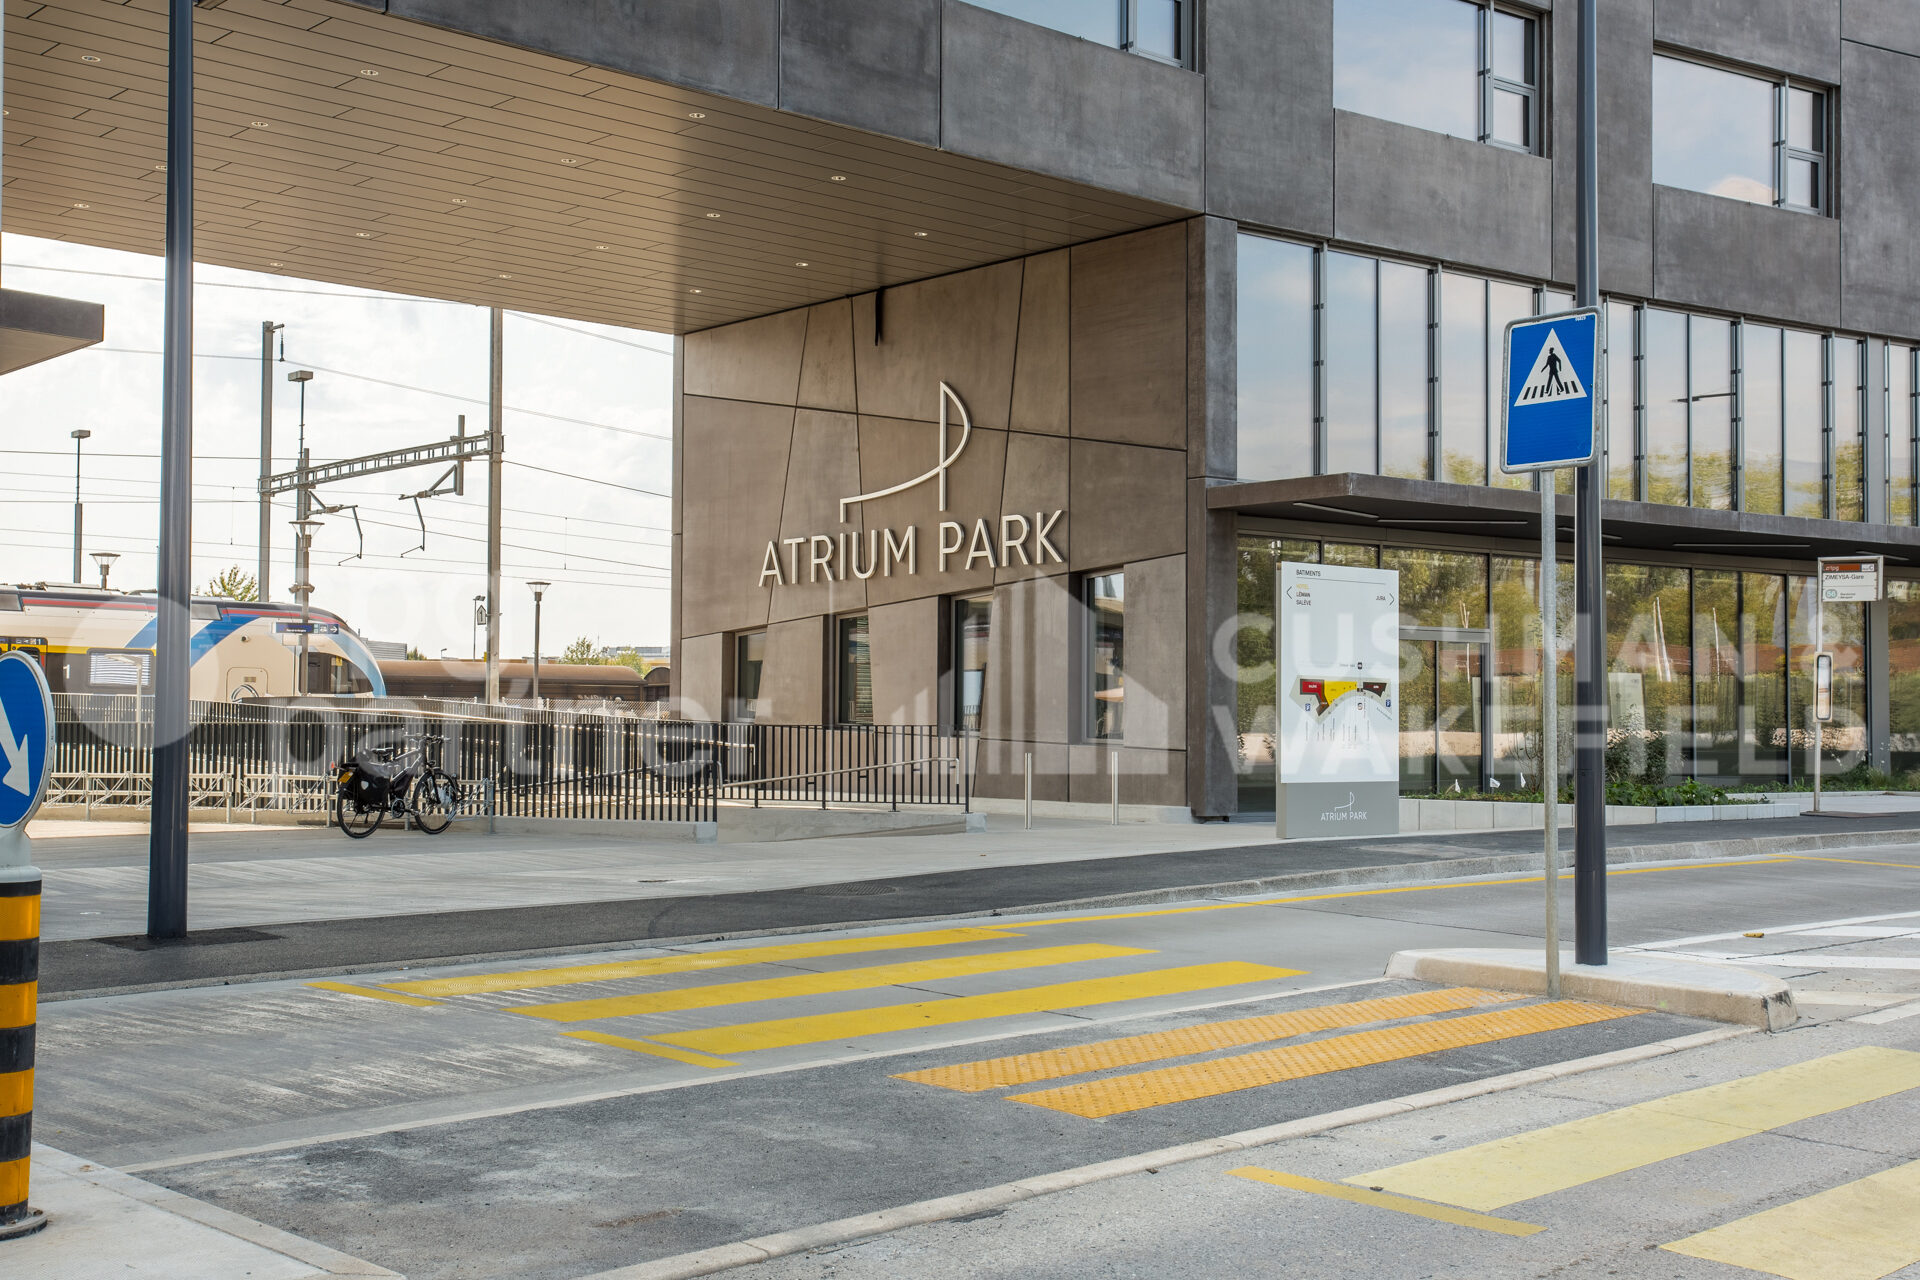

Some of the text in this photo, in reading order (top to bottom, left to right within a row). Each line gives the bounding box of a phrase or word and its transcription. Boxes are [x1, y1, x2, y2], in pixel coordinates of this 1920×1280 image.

[758, 509, 1066, 587] ATRIUM PARK
[62, 663, 71, 680] 1
[1320, 810, 1368, 822] ATRIUM PARK
